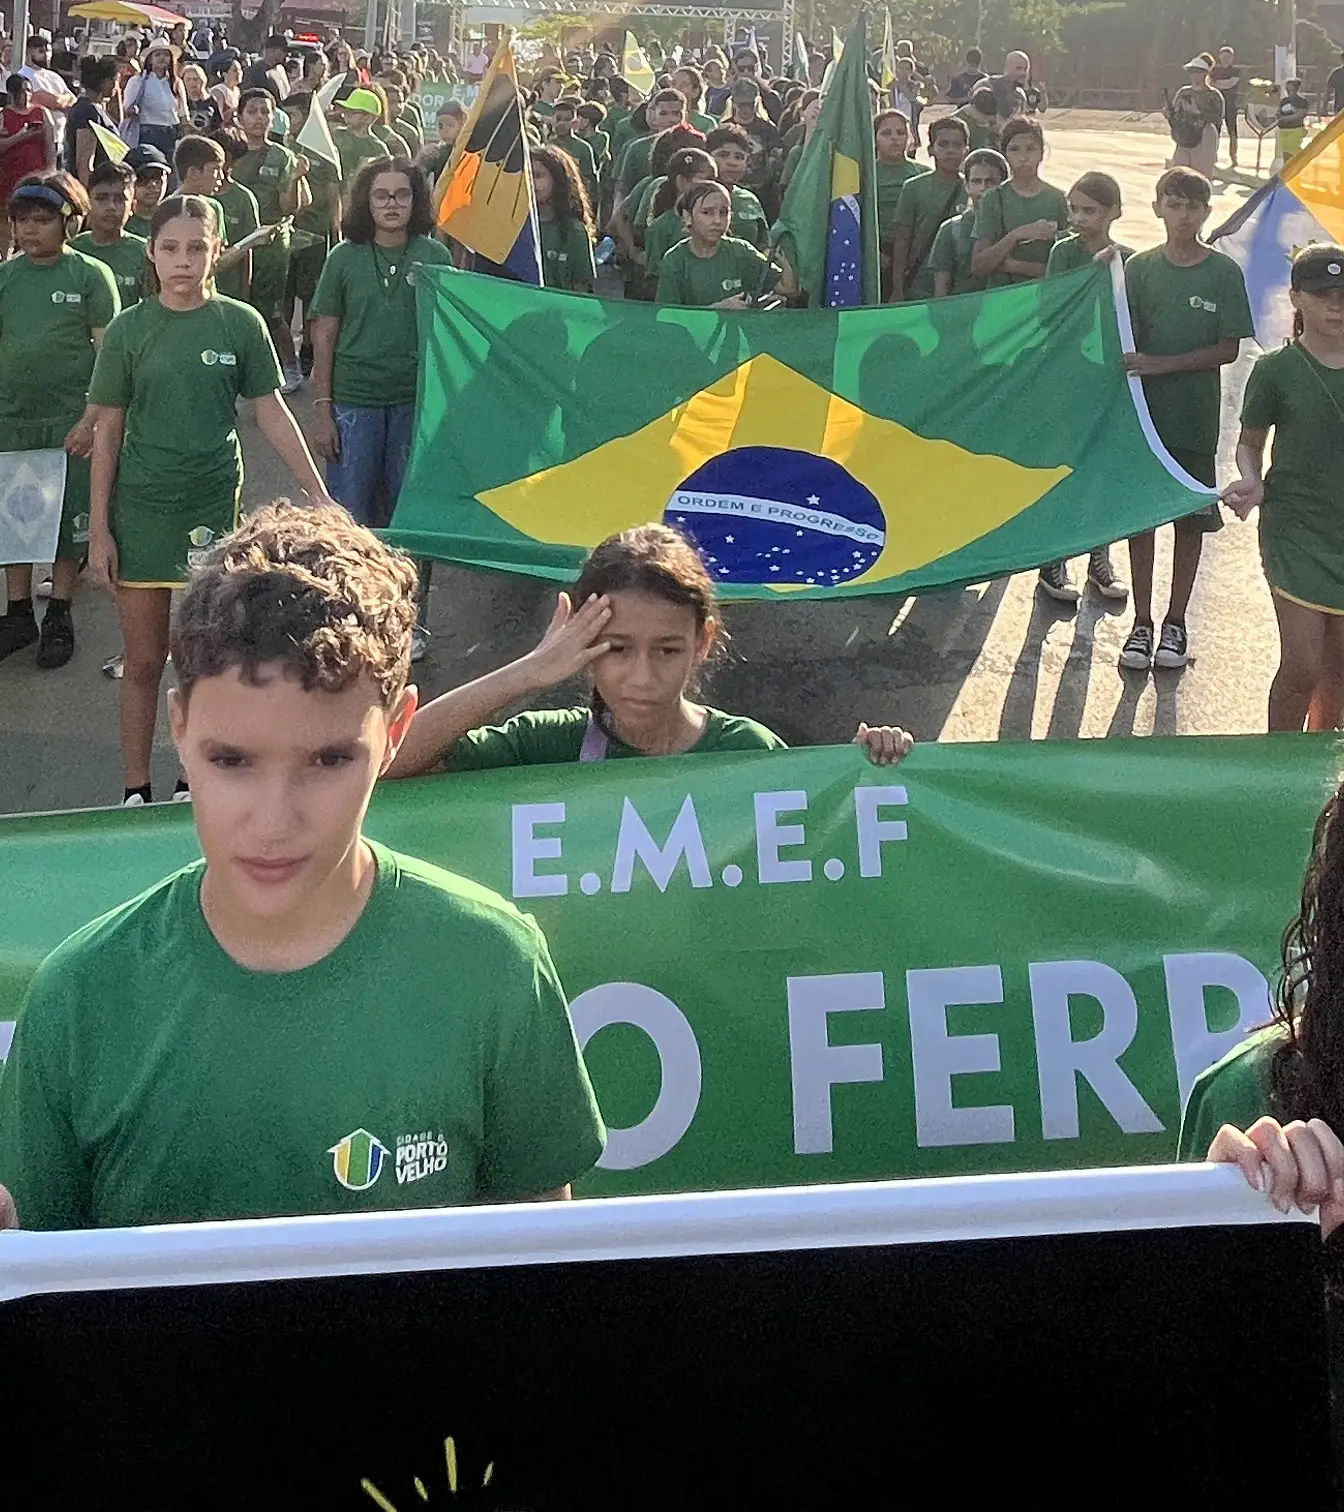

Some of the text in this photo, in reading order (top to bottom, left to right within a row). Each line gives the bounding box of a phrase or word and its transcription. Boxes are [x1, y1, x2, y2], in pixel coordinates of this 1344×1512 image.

[677, 495, 879, 541] ORDEM E PROGRESSO
[511, 785, 909, 898] E.M.E.F
[396, 1140, 448, 1167] PORTO
[396, 1156, 447, 1185] VELHO
